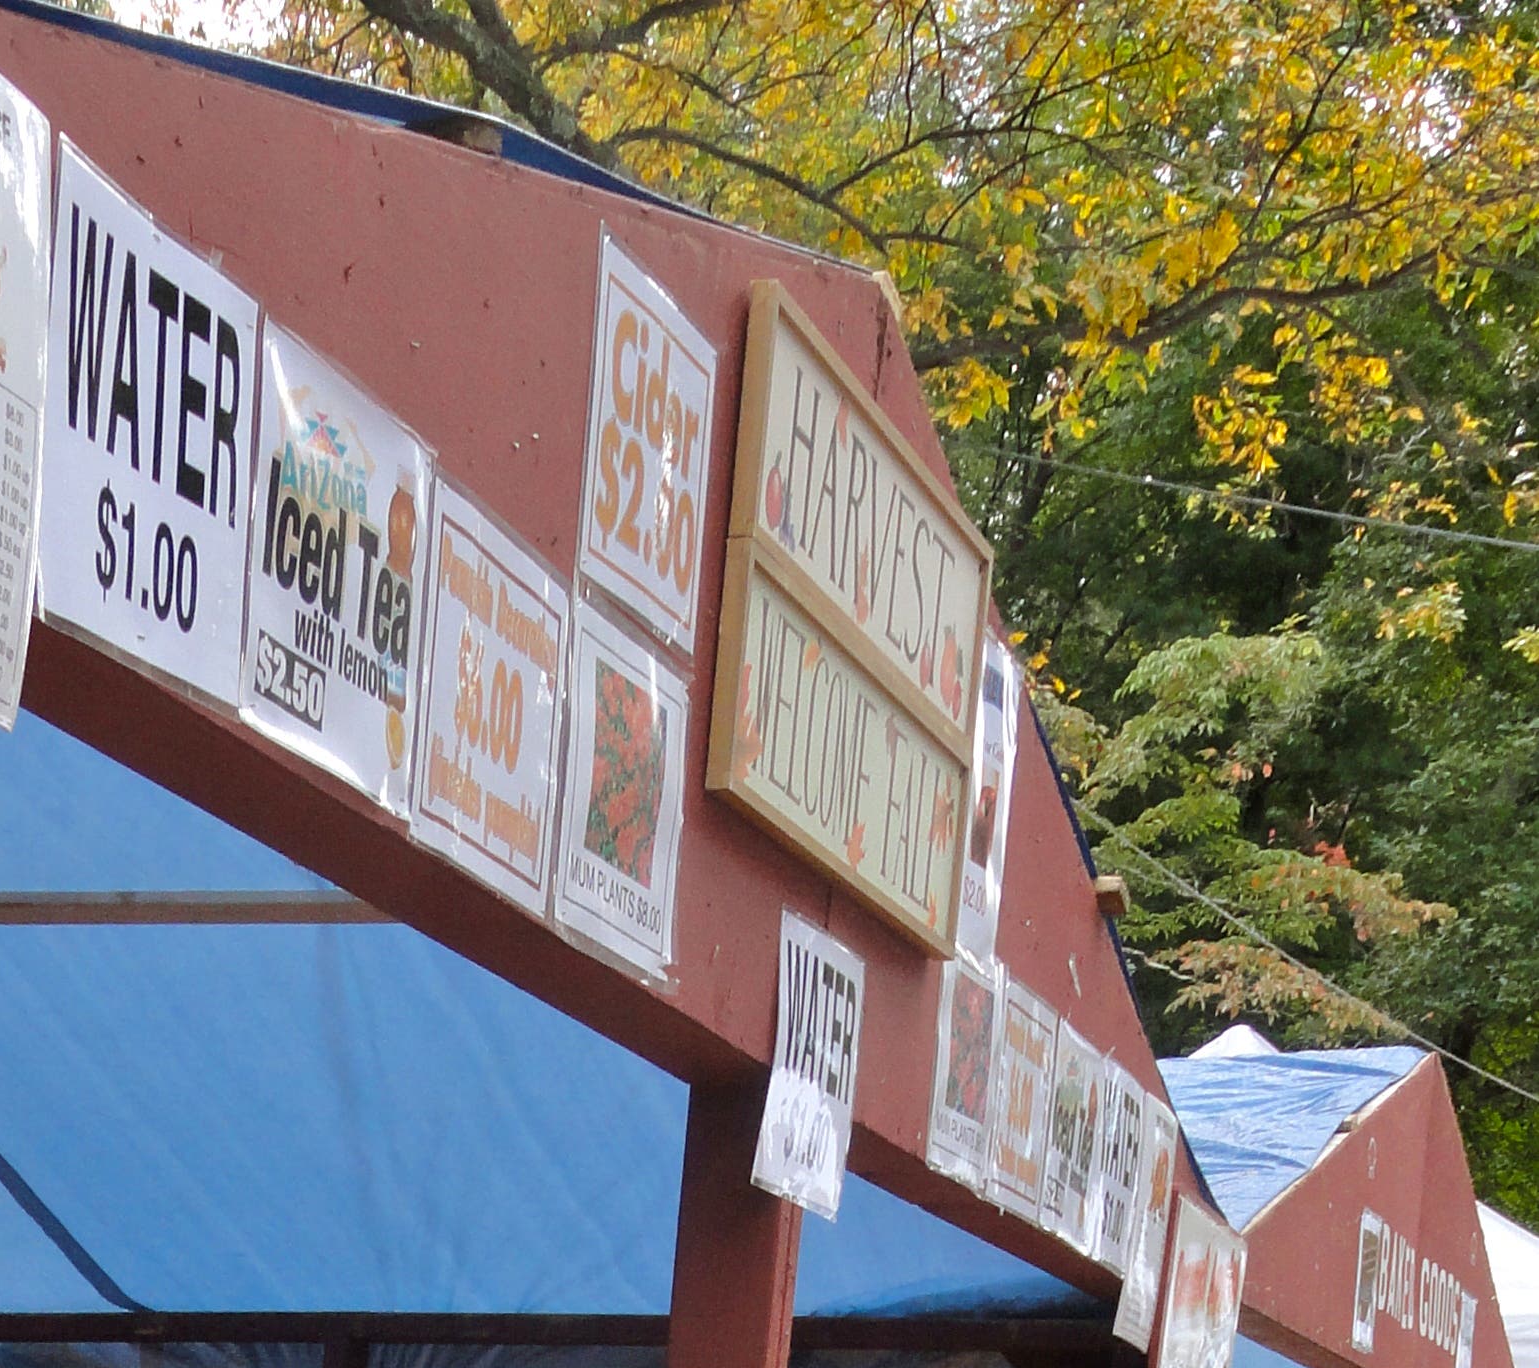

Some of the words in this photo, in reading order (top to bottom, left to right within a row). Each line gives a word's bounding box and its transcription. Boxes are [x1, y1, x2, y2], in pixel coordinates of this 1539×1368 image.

[67, 201, 241, 531] WATER
[611, 309, 700, 482] Cider
[94, 478, 198, 634] $1.00
[261, 455, 348, 624] Iced
[356, 522, 412, 671] Tea
[780, 365, 956, 689] HARVEST
[255, 632, 327, 725] $2.50
[294, 607, 334, 672] with
[338, 627, 390, 703] lemon
[750, 596, 879, 847] WELCOME
[879, 713, 941, 912] FALL
[568, 853, 596, 895] MUM
[596, 878, 635, 921] PLANTS
[635, 895, 662, 936] $8.00
[784, 939, 857, 1105] WATER
[1099, 1077, 1141, 1188] WATER
